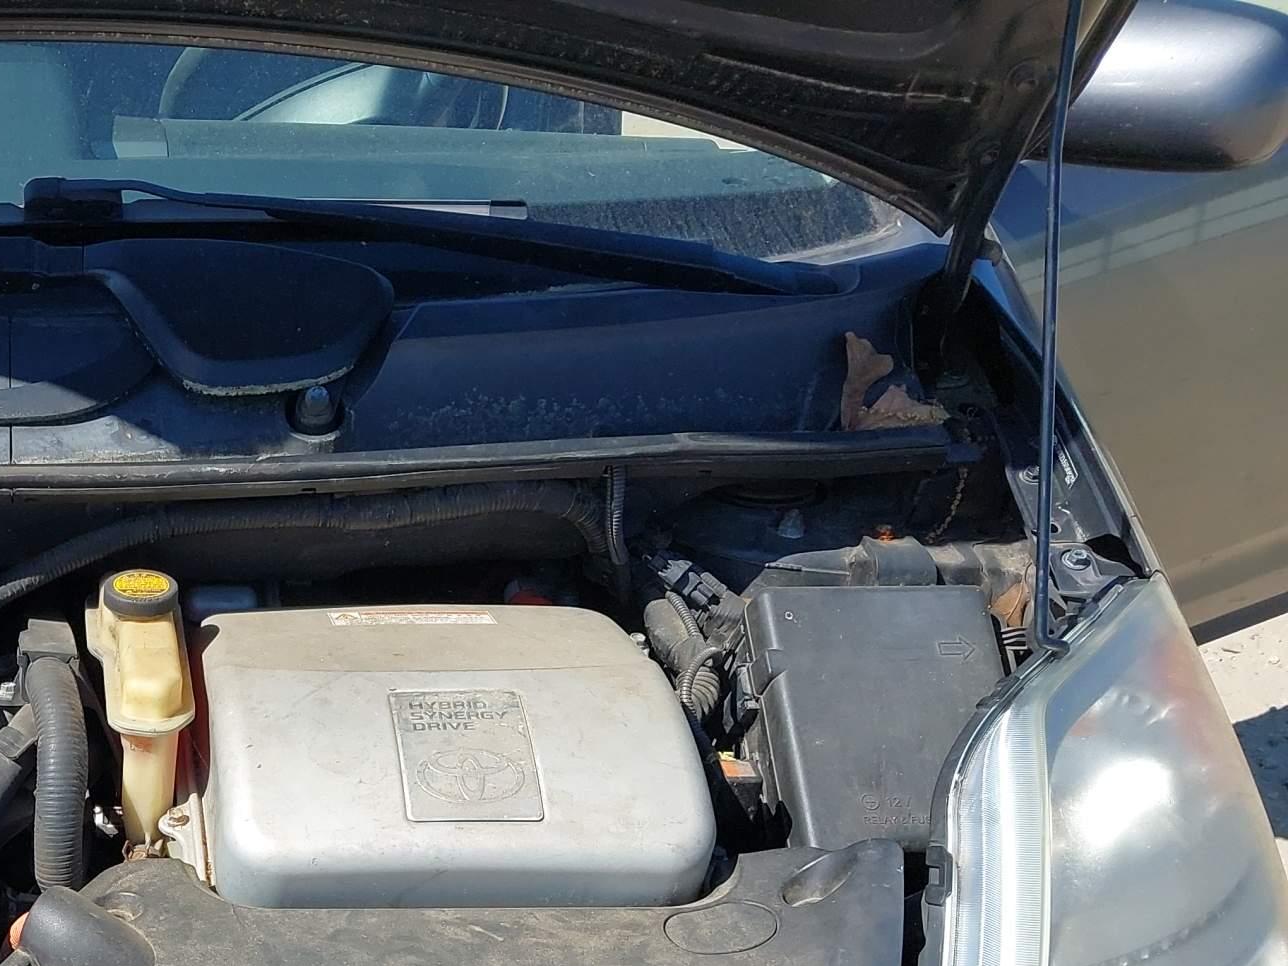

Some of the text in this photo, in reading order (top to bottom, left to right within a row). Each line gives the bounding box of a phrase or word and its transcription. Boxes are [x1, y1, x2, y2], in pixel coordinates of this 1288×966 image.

[408, 701, 487, 710] HYBRID
[410, 711, 508, 721] SYNERGY
[412, 721, 476, 732] DRIVE
[864, 815, 898, 825] RELAY
